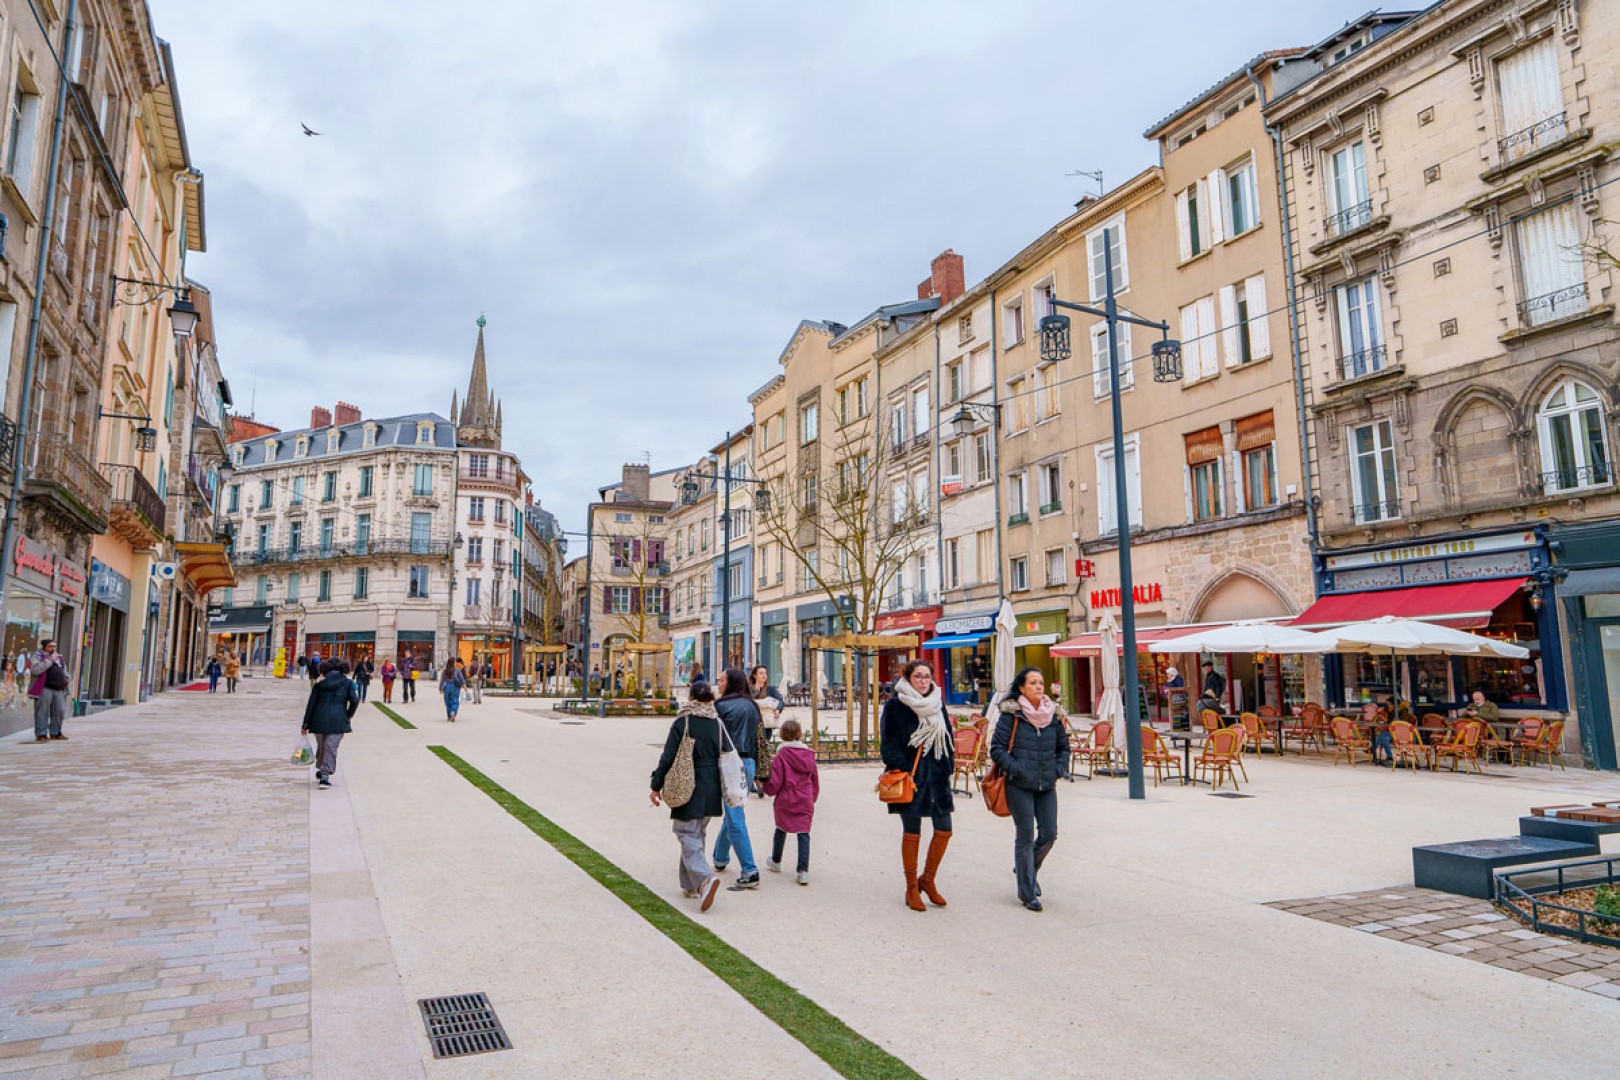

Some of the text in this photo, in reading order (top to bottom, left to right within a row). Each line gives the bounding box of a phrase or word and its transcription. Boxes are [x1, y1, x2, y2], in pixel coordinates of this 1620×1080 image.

[1373, 551, 1386, 563] LE
[1445, 540, 1475, 554] 1900
[1091, 582, 1162, 609] NATUALIA
